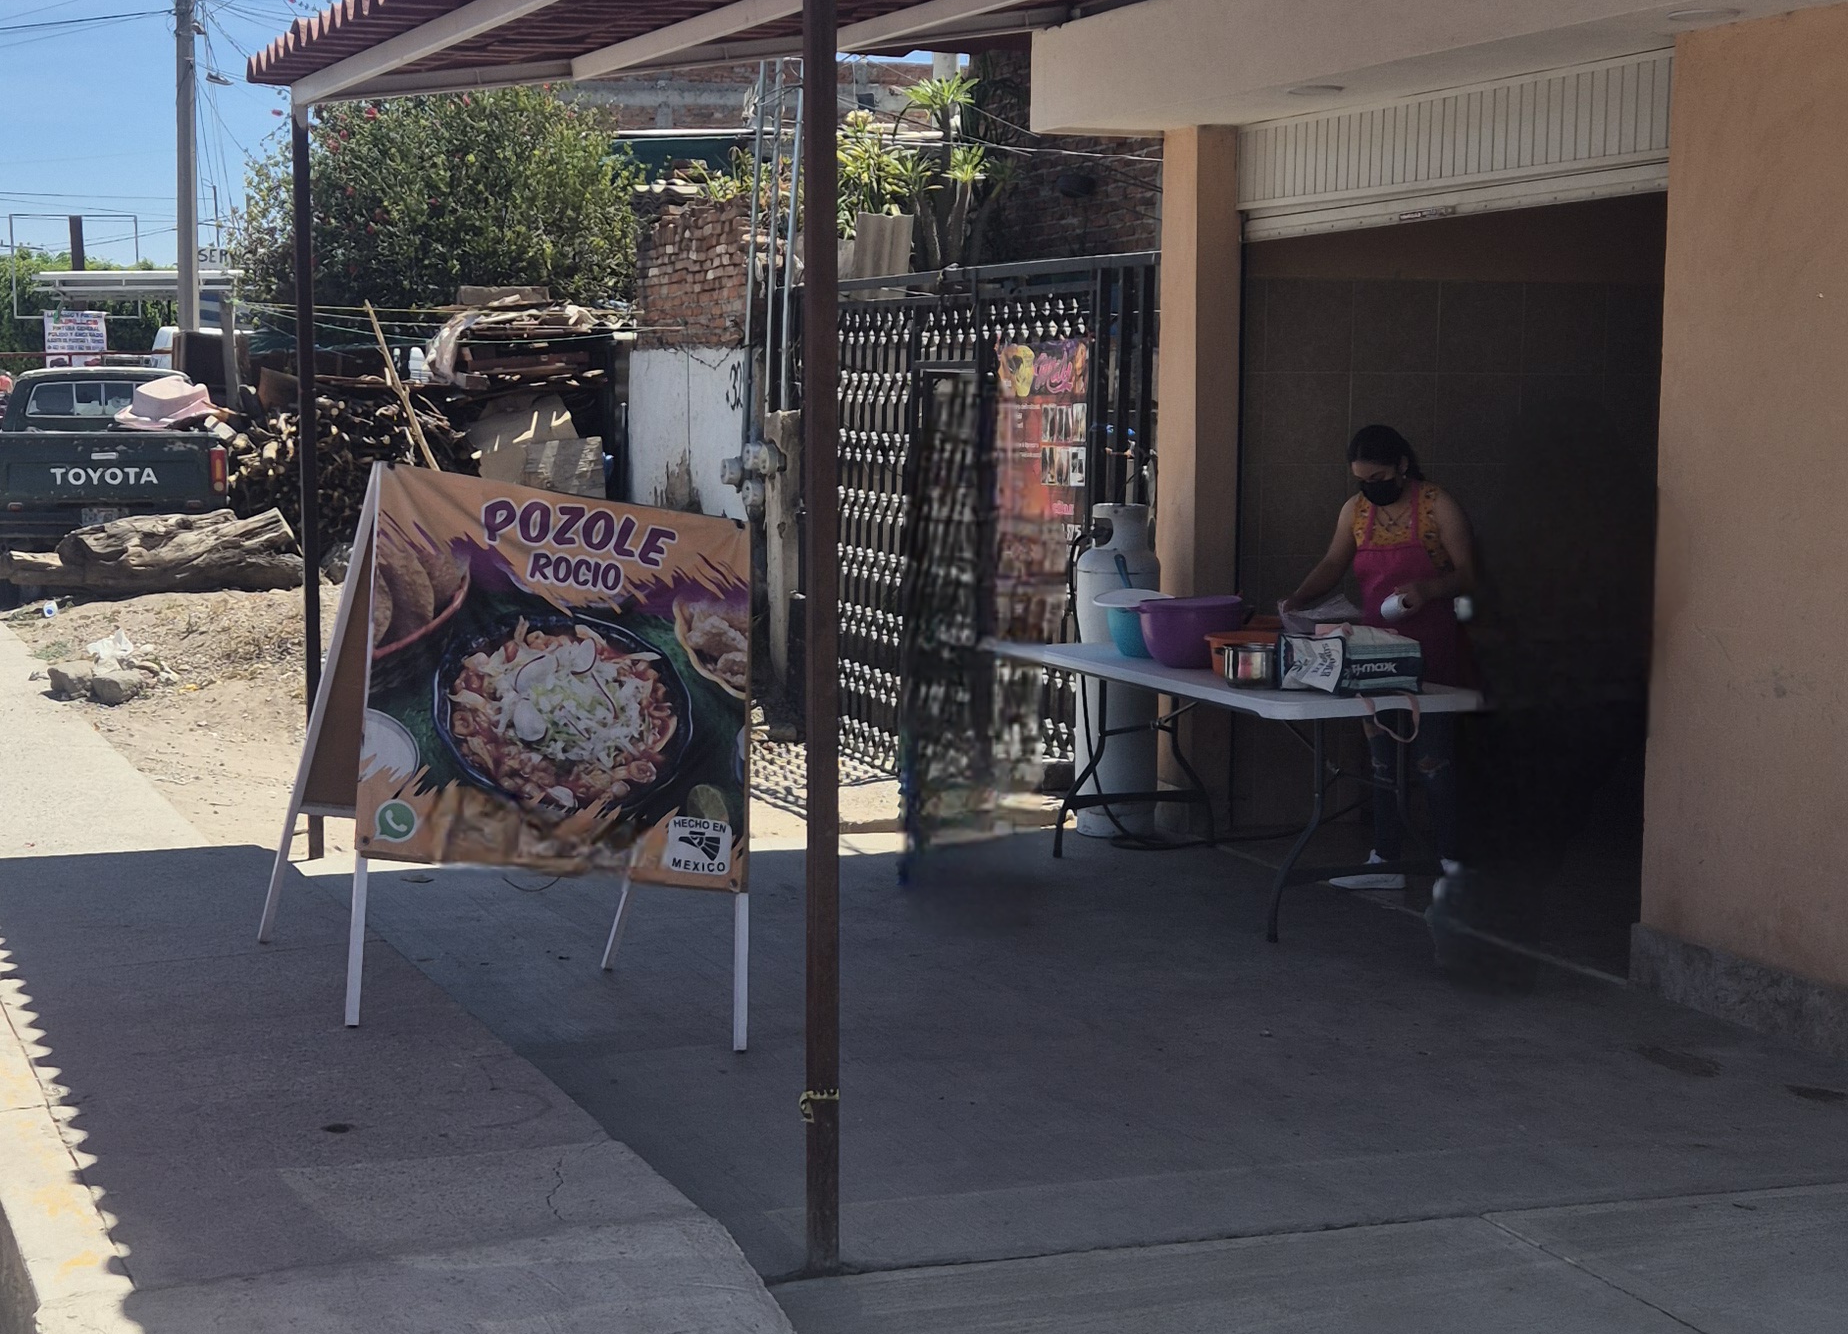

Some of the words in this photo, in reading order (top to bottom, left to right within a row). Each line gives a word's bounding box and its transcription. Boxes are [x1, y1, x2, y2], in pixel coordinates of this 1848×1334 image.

[49, 467, 159, 486] TOYOTA
[484, 499, 677, 567] POZOLE
[529, 552, 622, 591] ROCIO
[673, 818, 710, 830] HECHO
[712, 822, 727, 834] EN
[671, 857, 726, 873] MEXICO
